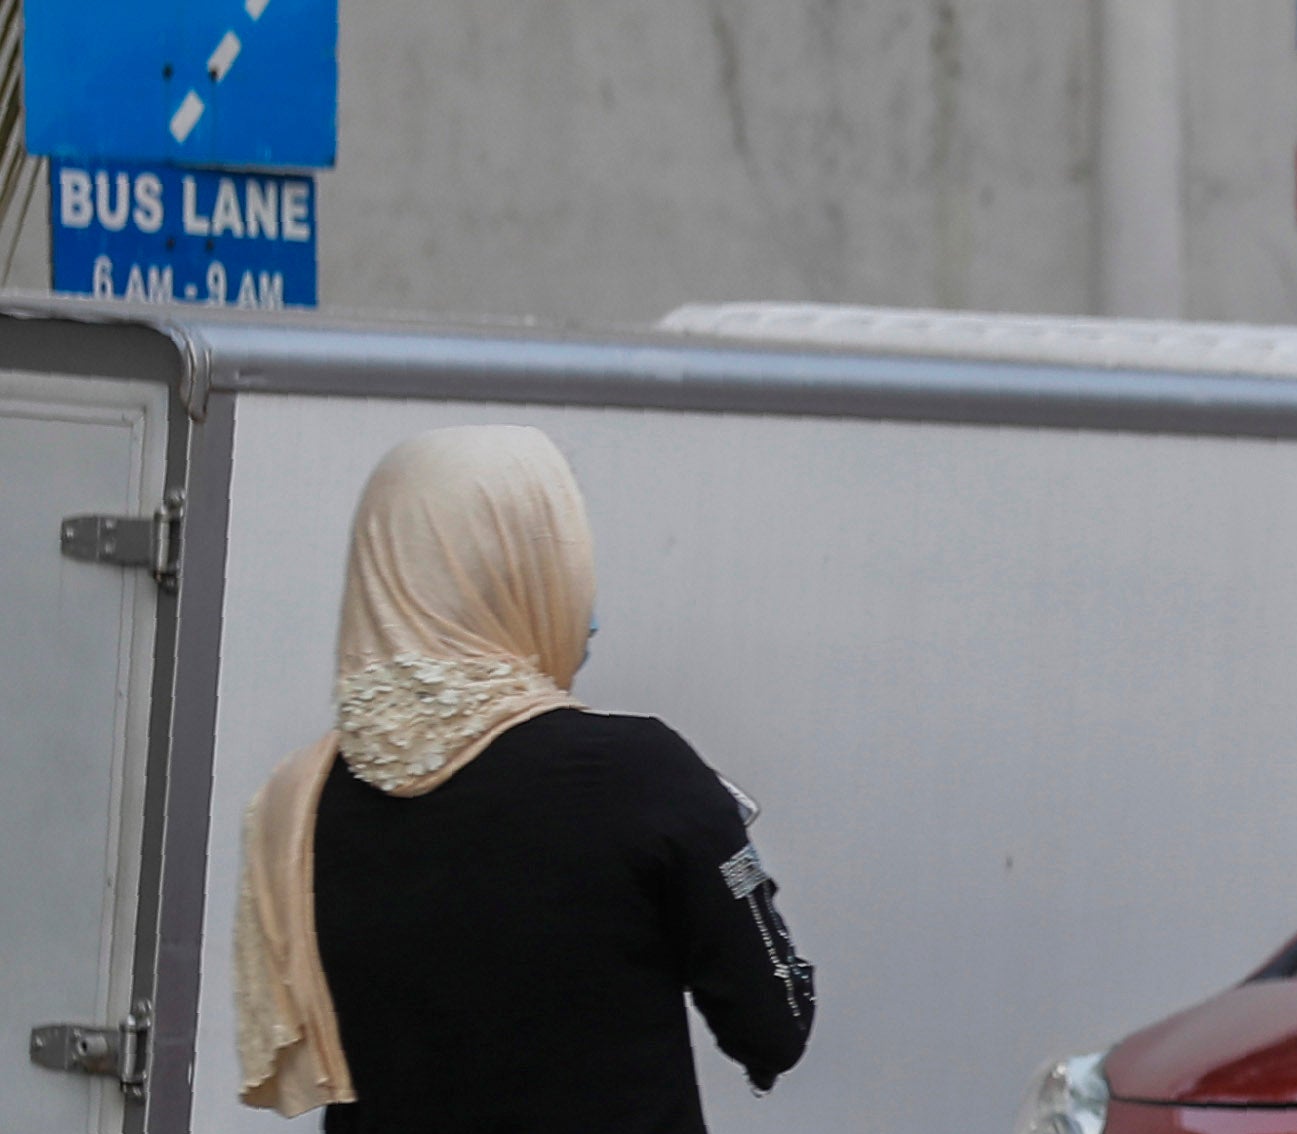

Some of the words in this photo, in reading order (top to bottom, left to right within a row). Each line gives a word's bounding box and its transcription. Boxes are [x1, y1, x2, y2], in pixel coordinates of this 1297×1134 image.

[60, 168, 164, 233] BUS
[182, 175, 310, 243] LANE
[93, 253, 114, 301] 6
[124, 262, 174, 304] AM
[206, 259, 227, 306] 9
[237, 269, 284, 310] AM
